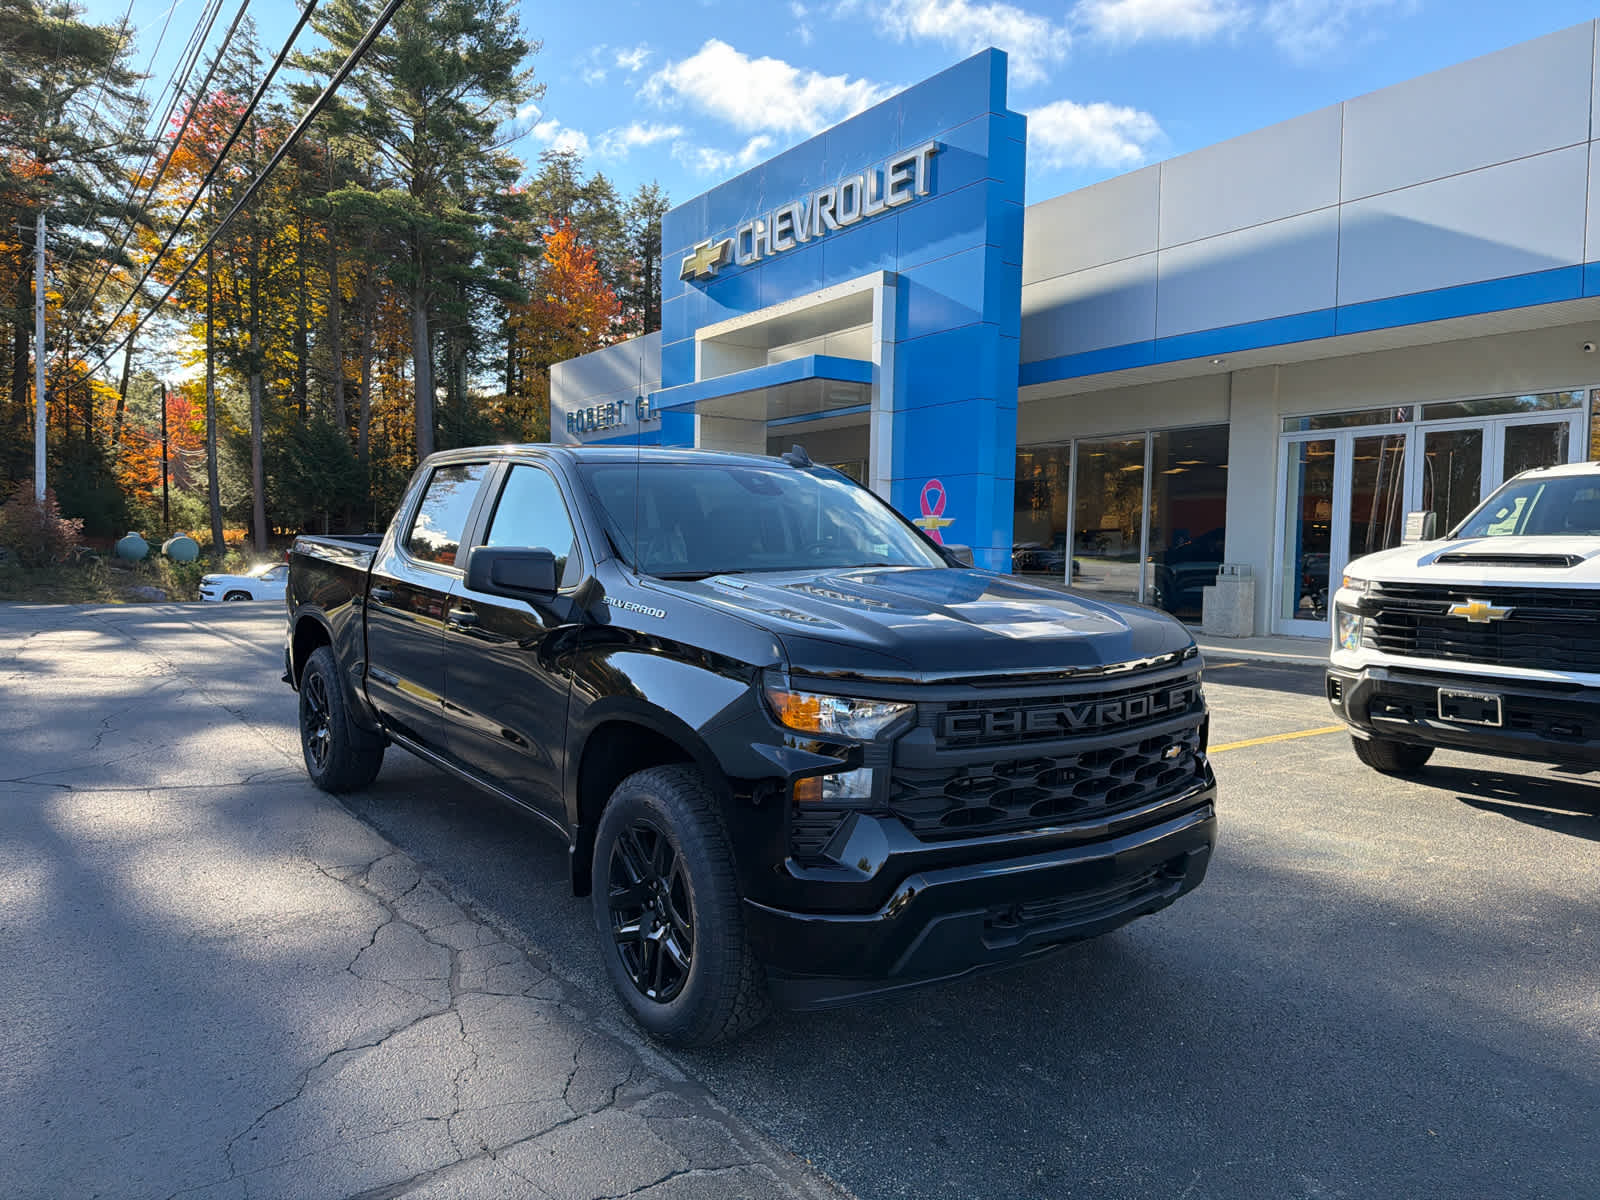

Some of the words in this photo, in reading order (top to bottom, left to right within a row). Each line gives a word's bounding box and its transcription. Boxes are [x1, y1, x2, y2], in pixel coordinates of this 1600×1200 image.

[734, 139, 939, 266] CHEVROLET
[566, 399, 625, 434] ROBERT
[602, 595, 667, 619] SILVERADO
[945, 682, 1200, 737] CHEVROLET
